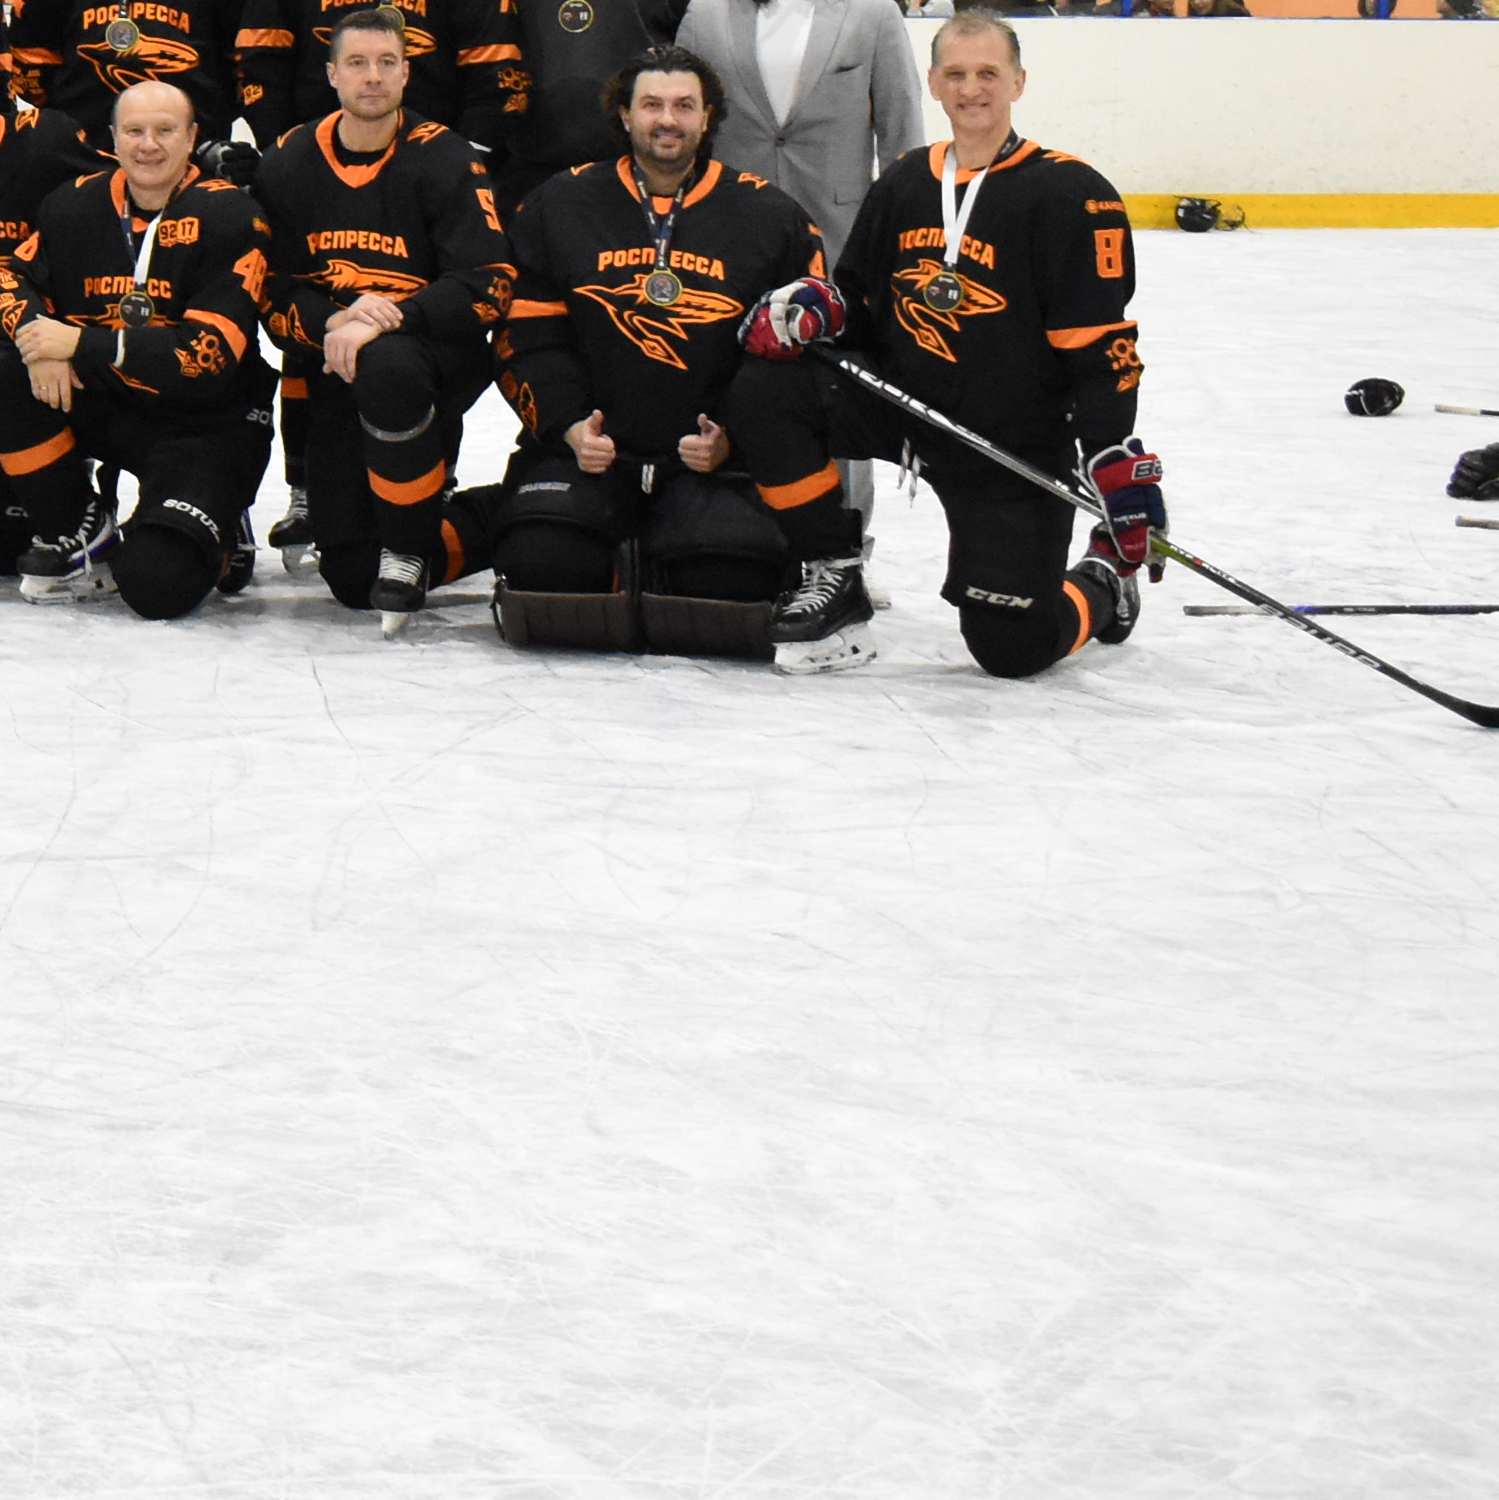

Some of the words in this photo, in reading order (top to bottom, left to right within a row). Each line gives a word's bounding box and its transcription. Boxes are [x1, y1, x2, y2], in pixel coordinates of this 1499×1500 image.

[597, 247, 726, 282] РОСПЕССА
[162, 498, 221, 544] SOYUZ
[965, 584, 1034, 609] CCM
